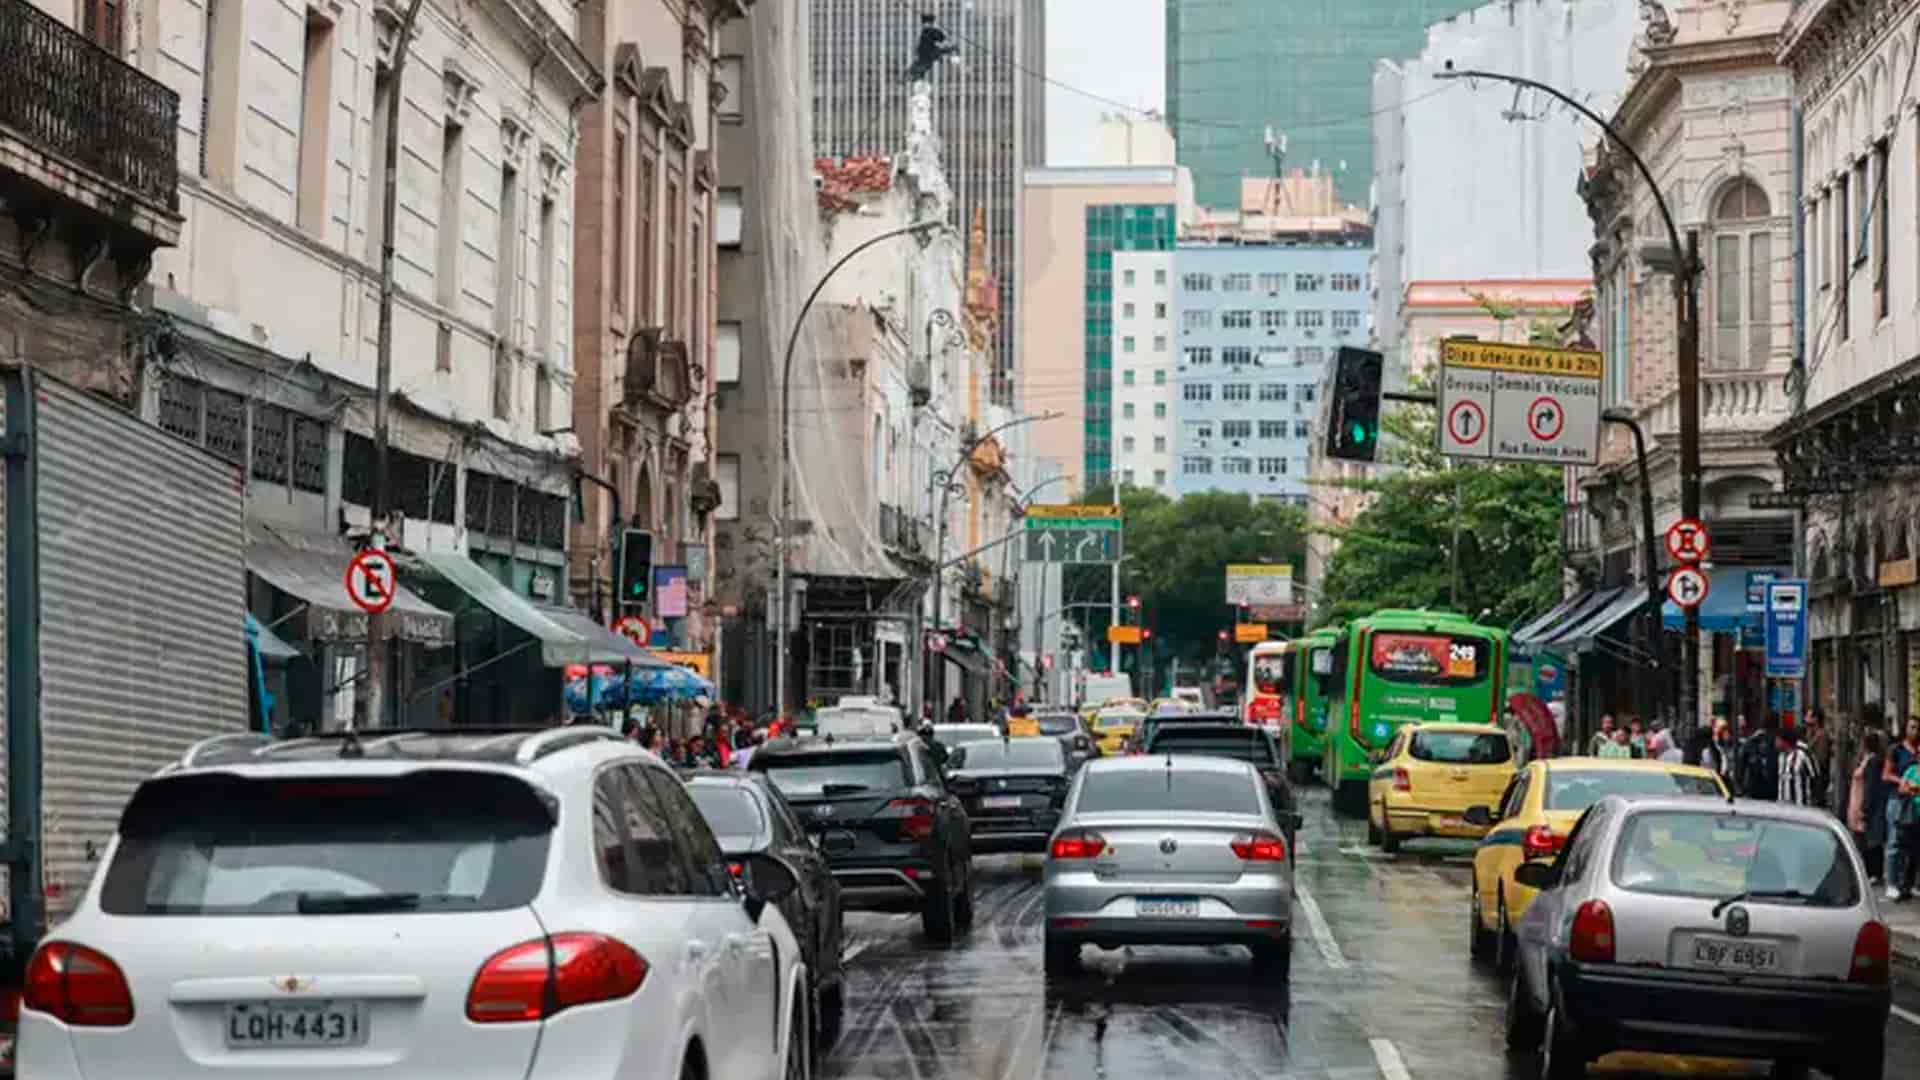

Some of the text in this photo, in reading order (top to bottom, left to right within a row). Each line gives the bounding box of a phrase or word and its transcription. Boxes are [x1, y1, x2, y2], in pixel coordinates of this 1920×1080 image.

[1447, 346, 1475, 361] Dias
[1519, 353, 1541, 367] das
[1499, 440, 1519, 453] Rua
